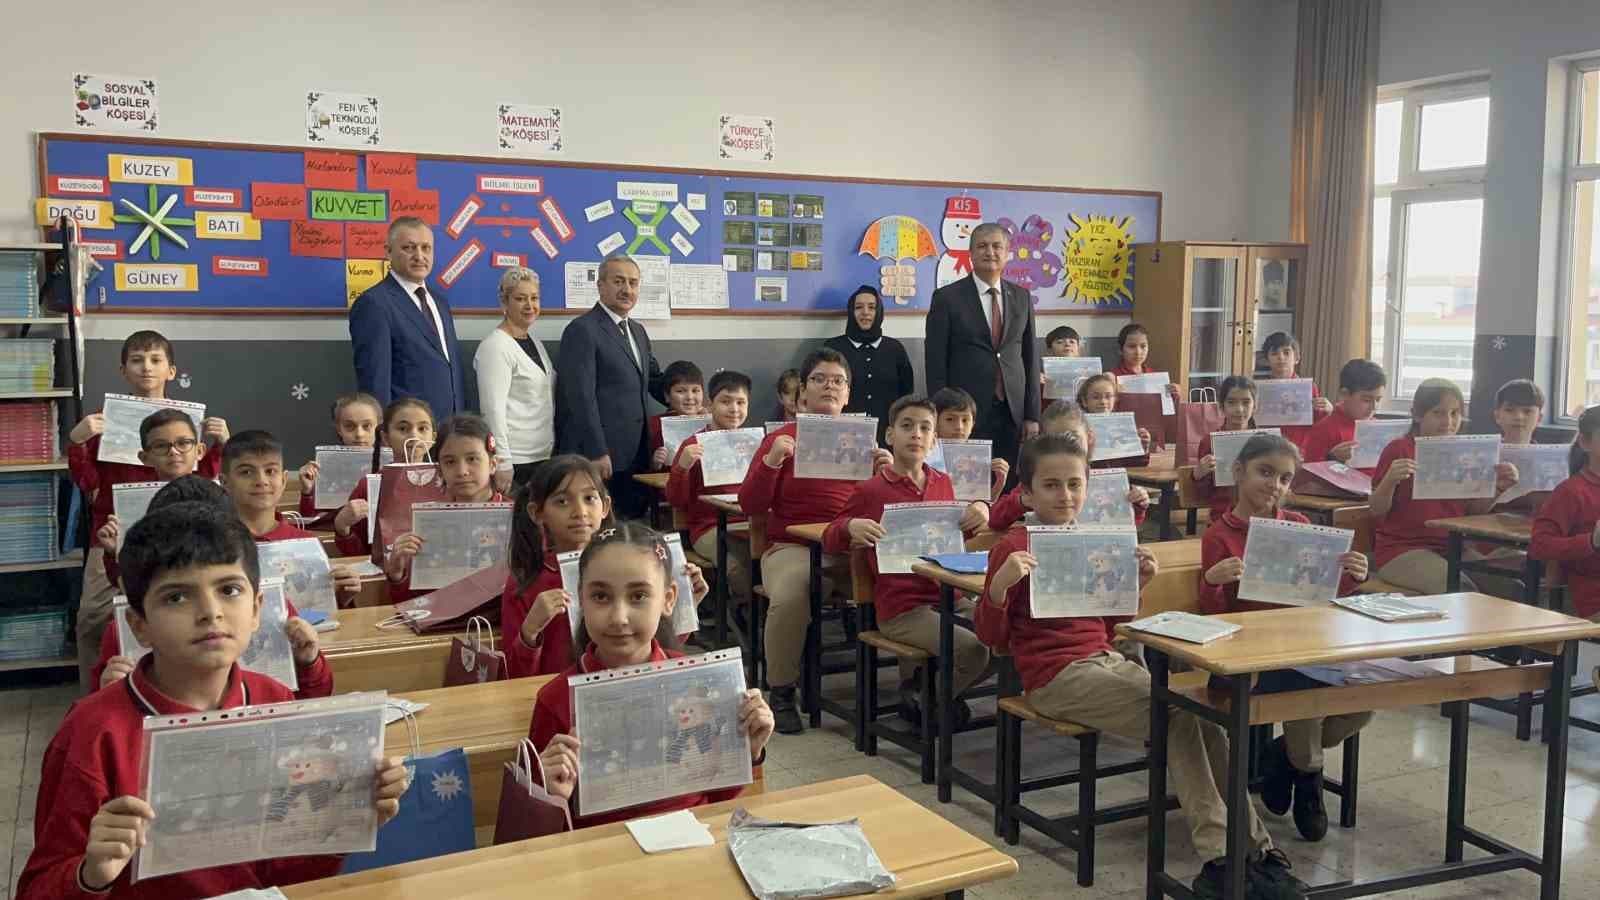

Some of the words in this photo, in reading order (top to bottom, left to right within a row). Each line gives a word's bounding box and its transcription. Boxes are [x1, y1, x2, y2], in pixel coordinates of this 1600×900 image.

[104, 83, 147, 96] SOSYAL
[101, 95, 150, 108] BİLGİLER
[338, 102, 355, 113] FEN
[357, 104, 369, 113] VE
[106, 109, 147, 121] KÖŞESİ
[331, 113, 377, 125] TEKNOLOJİ
[502, 115, 559, 128] MATEMATİK
[338, 125, 370, 137] KÖŞESİ
[512, 129, 550, 142] KÖŞESİ
[730, 126, 765, 139] TÜRKÇE
[124, 162, 171, 178] KUZEY
[49, 205, 96, 221] DOĞU
[314, 197, 383, 217] KUVVET
[208, 219, 239, 233] BATI
[128, 272, 178, 284] GÜNEY
